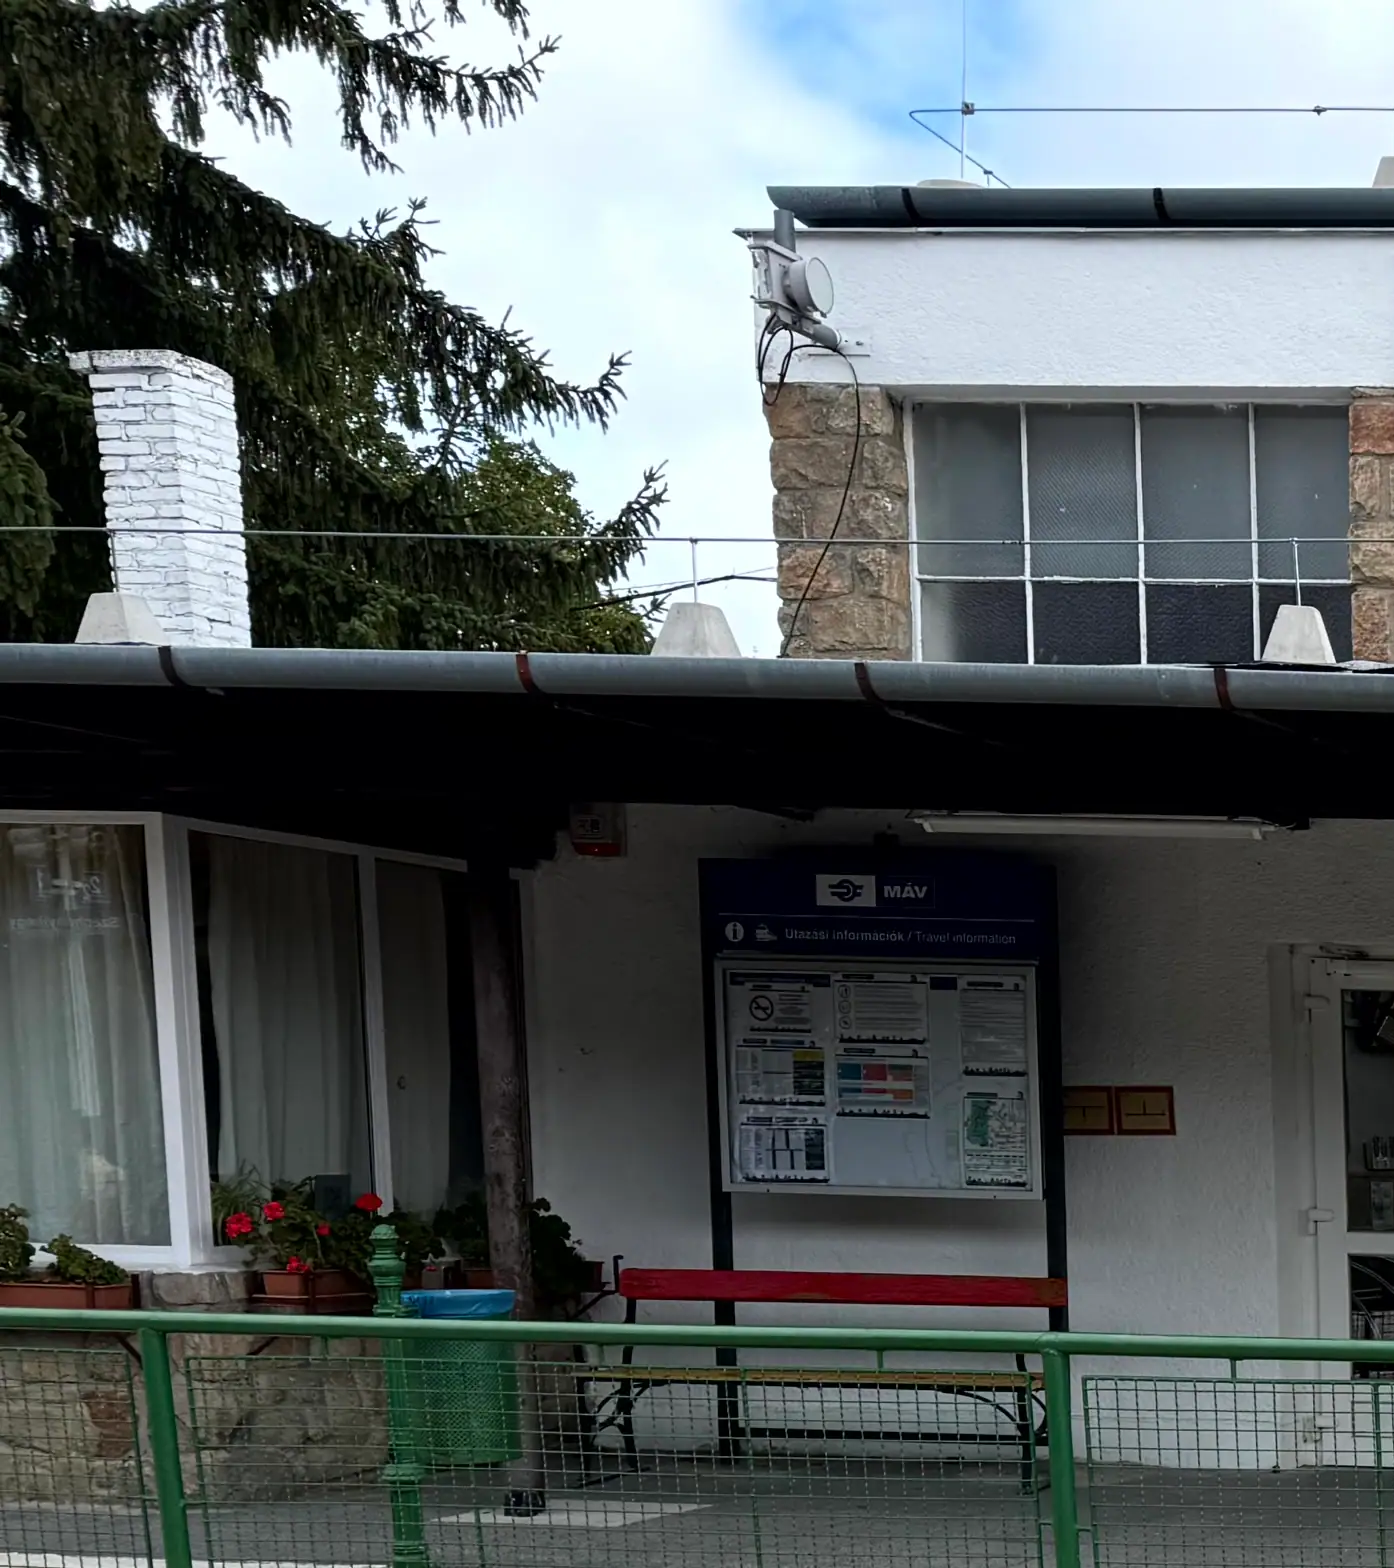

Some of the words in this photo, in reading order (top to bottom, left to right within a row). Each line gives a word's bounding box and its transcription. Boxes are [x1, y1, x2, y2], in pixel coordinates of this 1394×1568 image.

[883, 880, 928, 899] MÁV
[784, 927, 829, 941] Utazási
[915, 930, 950, 944] Travel
[952, 932, 1016, 945] information
